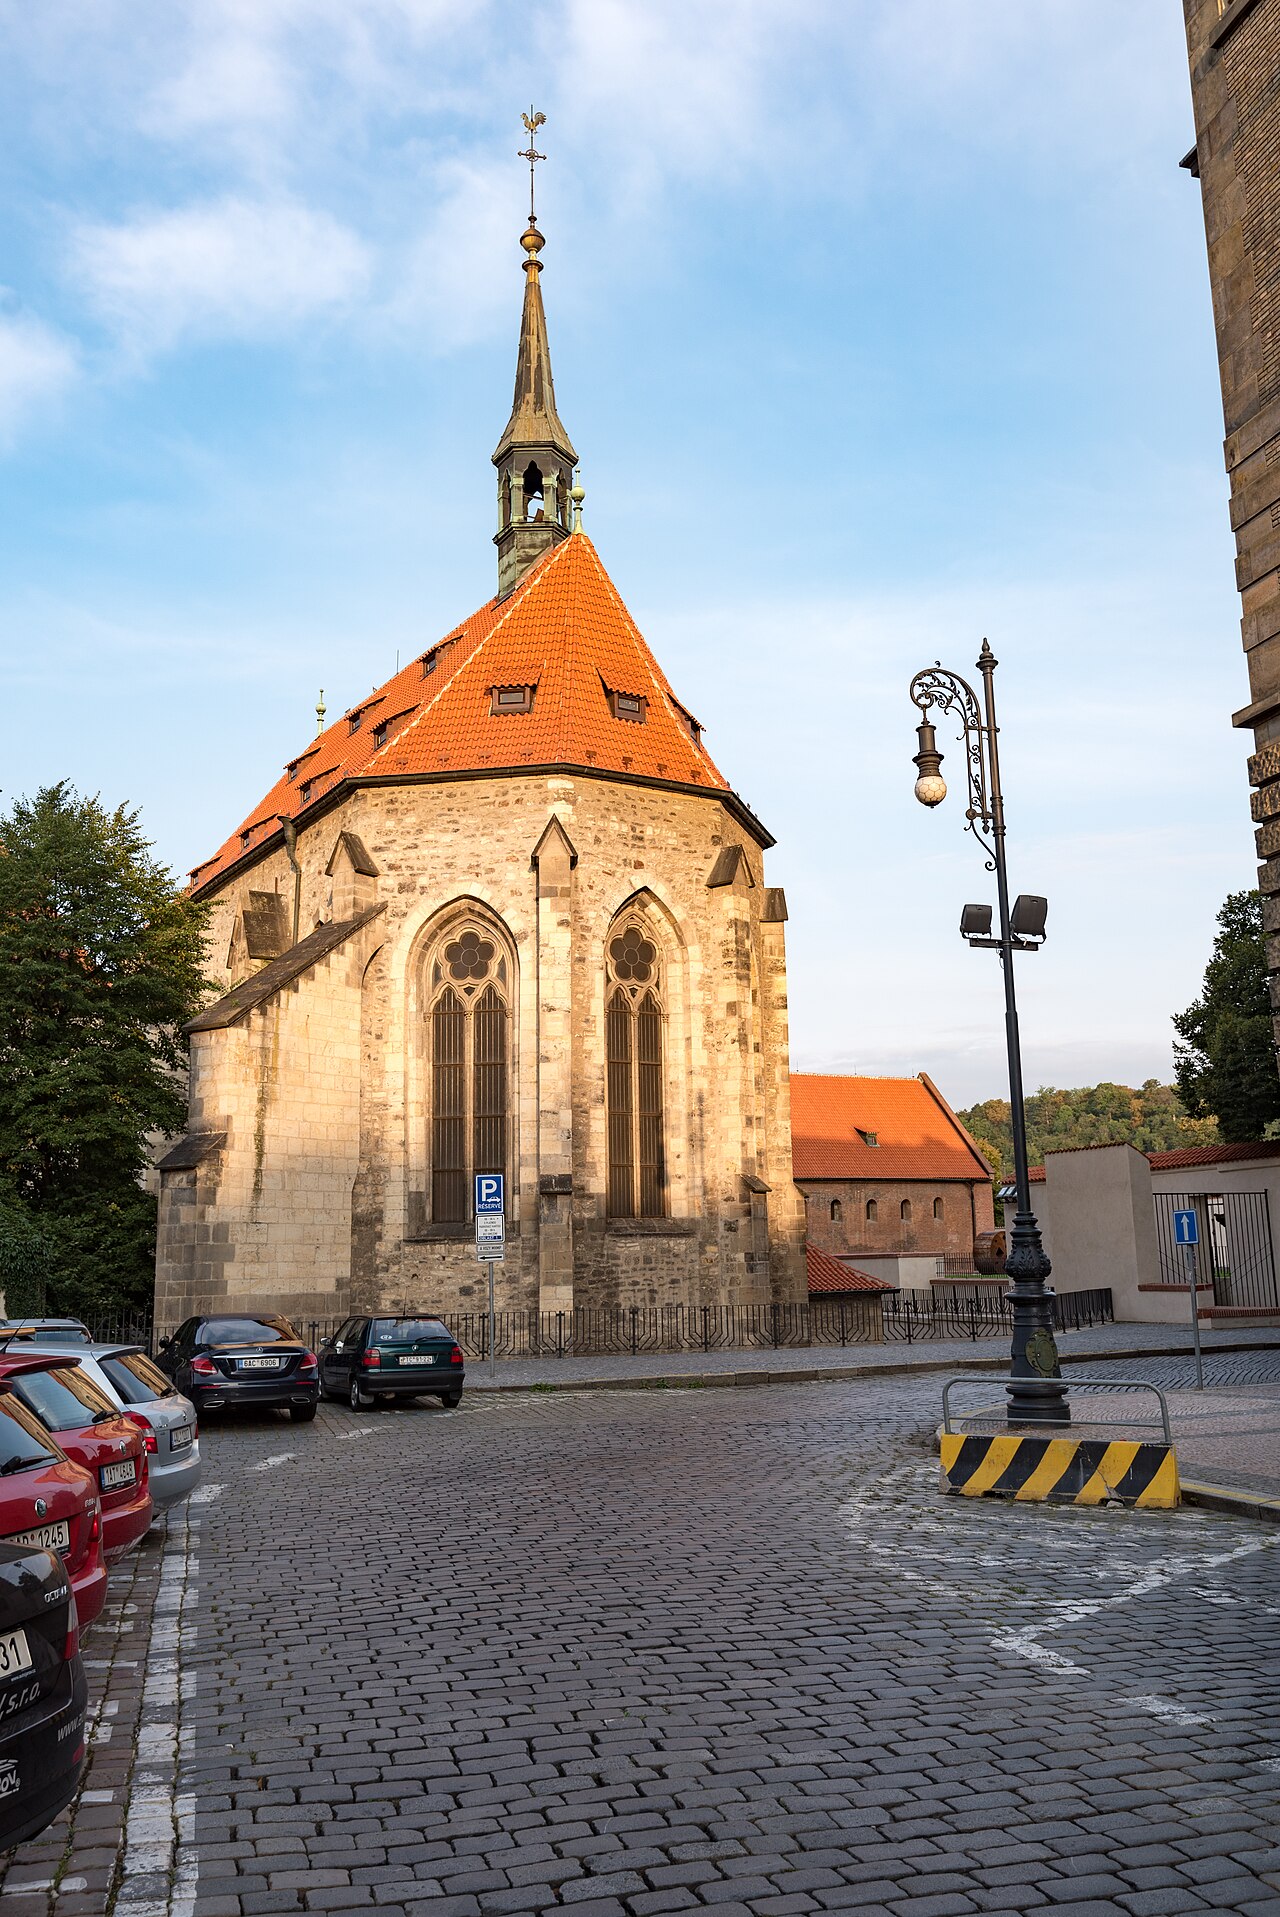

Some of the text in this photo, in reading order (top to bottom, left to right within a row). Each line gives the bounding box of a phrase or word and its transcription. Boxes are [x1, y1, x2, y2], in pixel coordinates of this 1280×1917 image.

[481, 1180, 497, 1201] P
[38, 1524, 64, 1548] 1245
[6, 1682, 41, 1714] s.r.o.
